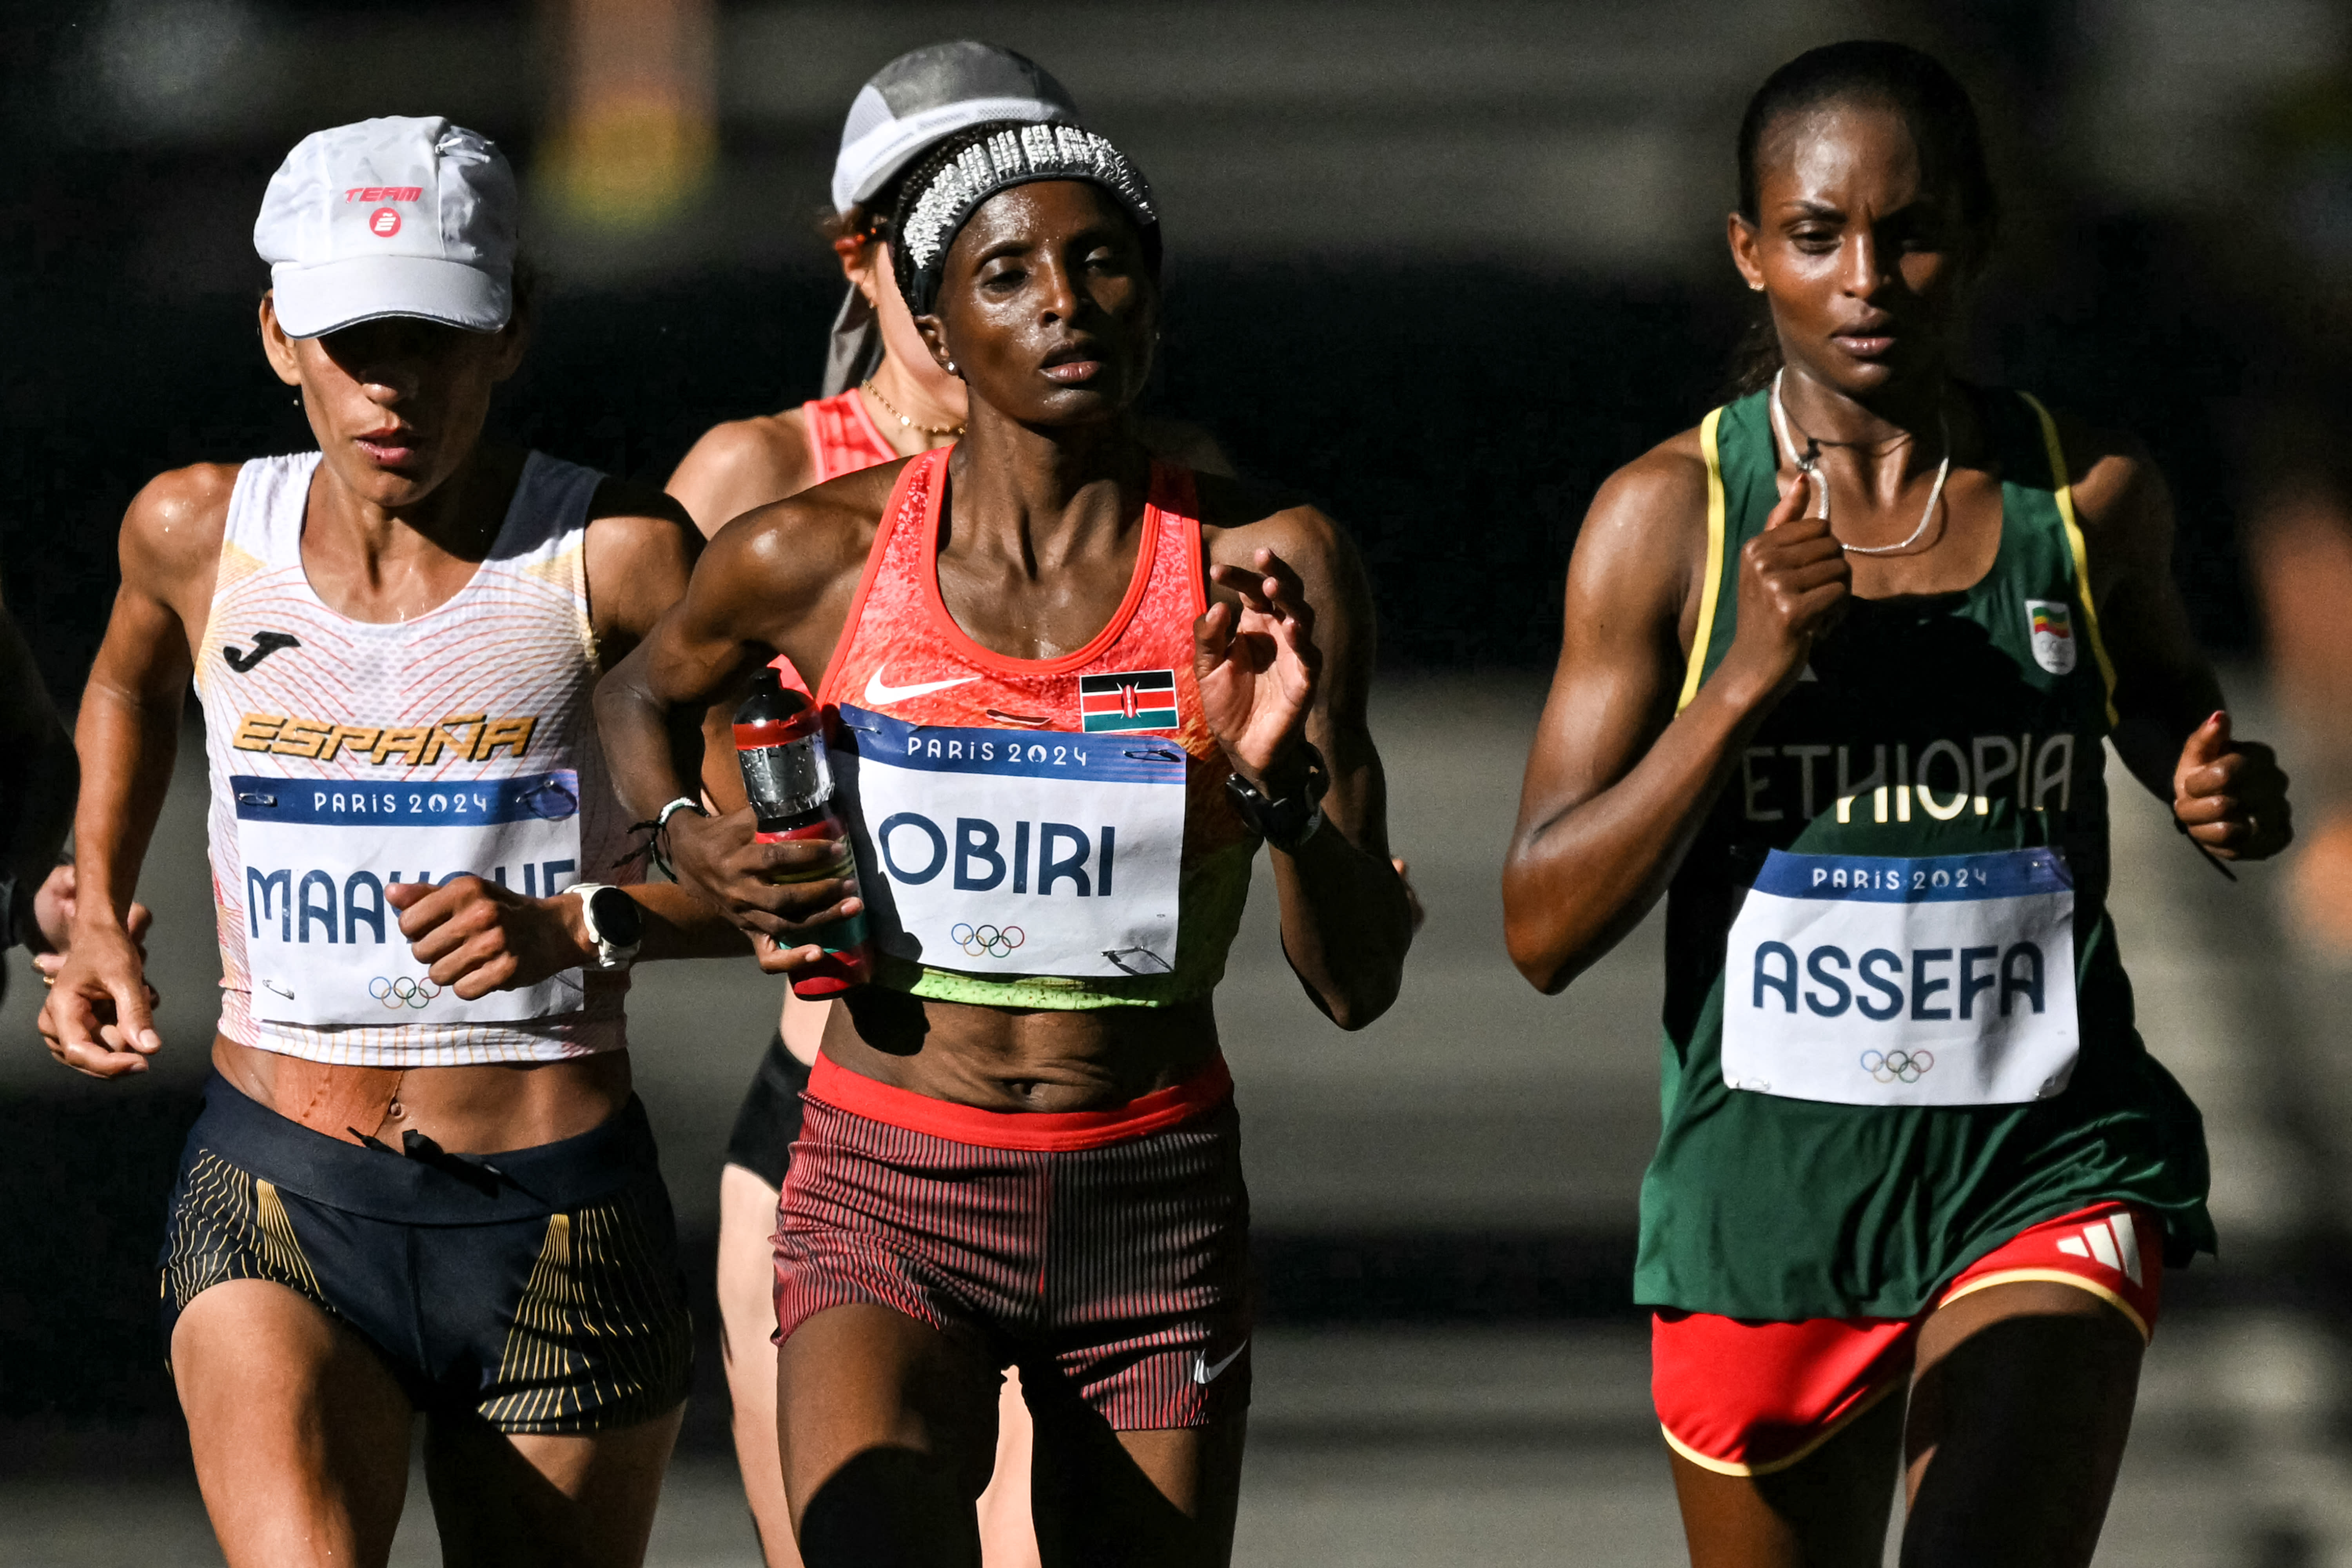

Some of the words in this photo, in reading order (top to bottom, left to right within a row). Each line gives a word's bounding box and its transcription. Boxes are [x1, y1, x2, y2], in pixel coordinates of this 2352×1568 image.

[345, 187, 423, 203] TEAM
[232, 712, 538, 766] ESPAÑA
[1008, 743, 1086, 767] 2024
[1742, 733, 2075, 824] ETHIOPIA
[409, 793, 486, 813] 2024
[878, 811, 1115, 897] OBIRI
[1912, 868, 1987, 890] 2024
[1752, 940, 2045, 1021] ASSEFA
